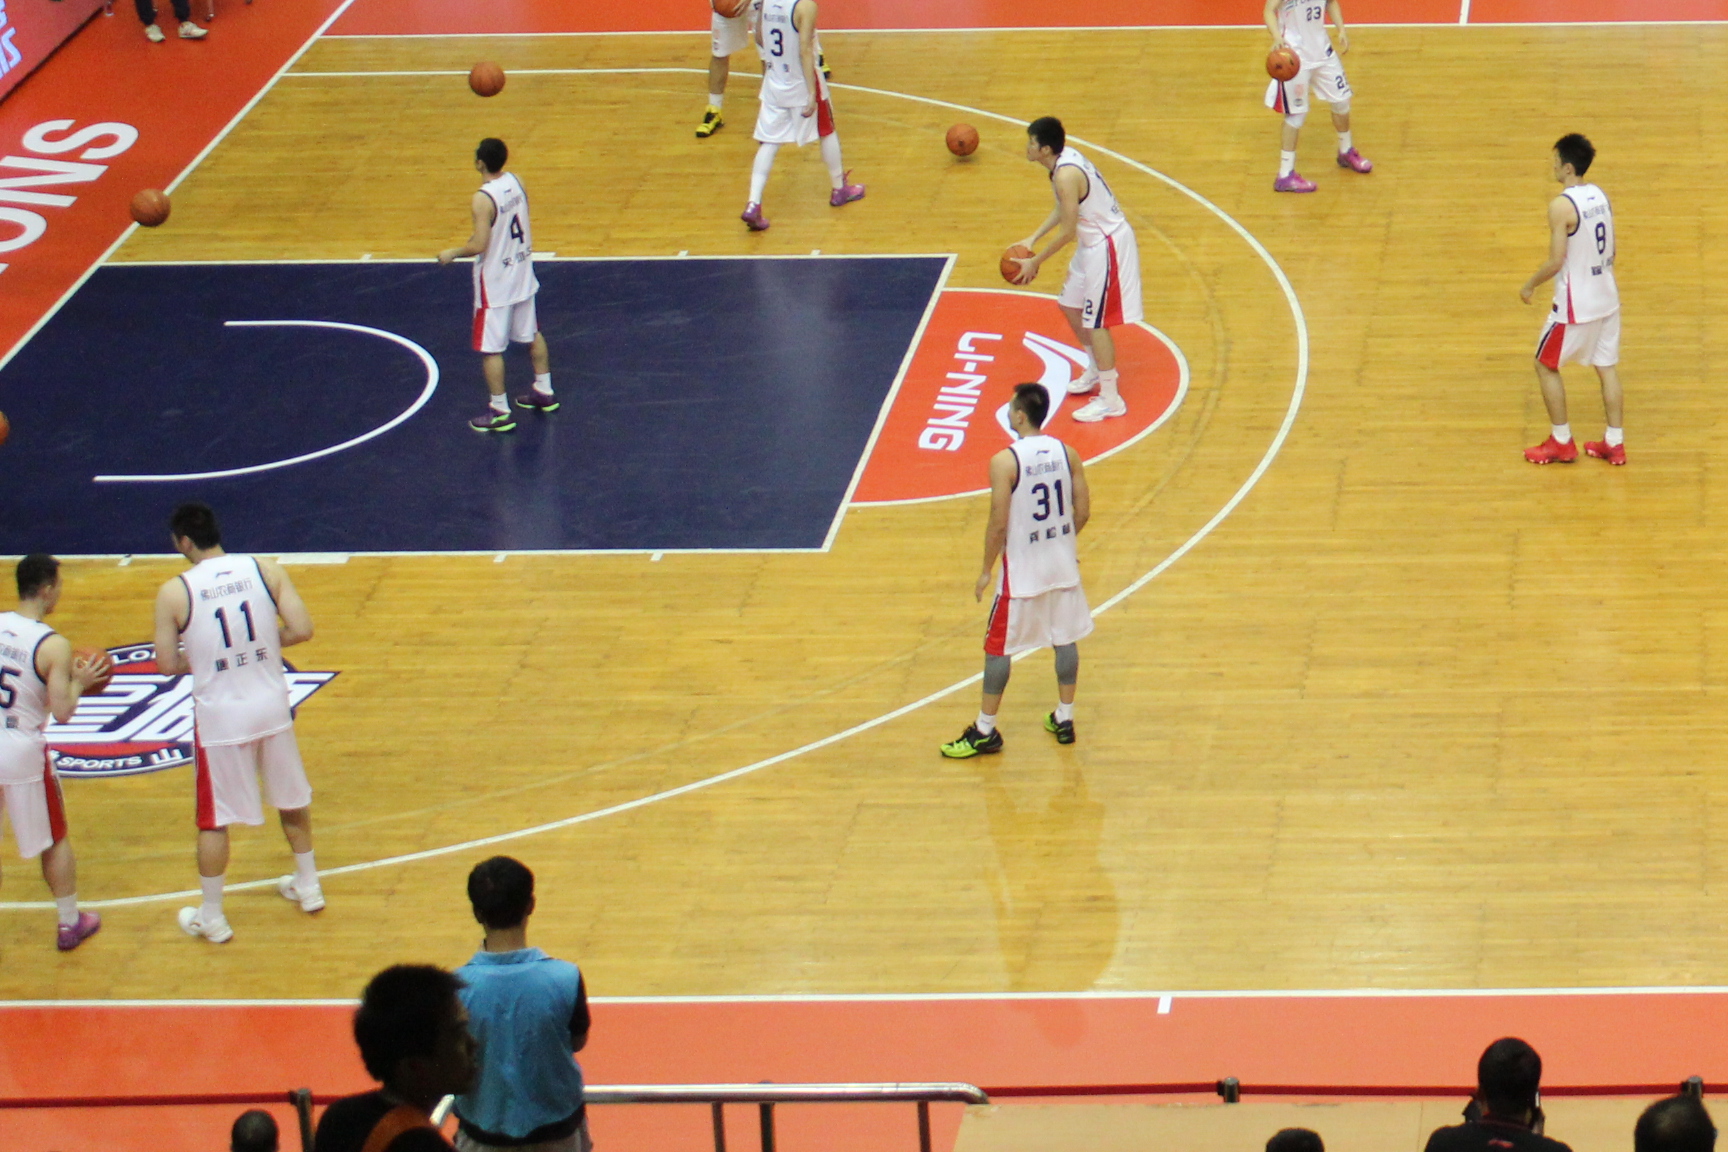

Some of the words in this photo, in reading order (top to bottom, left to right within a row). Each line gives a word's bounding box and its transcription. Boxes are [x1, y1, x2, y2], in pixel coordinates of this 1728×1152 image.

[1306, 6, 1321, 21] 23
[770, 29, 783, 57] 3
[510, 213, 524, 244] 4
[918, 331, 1003, 451] LI-NING
[1031, 478, 1064, 522] 31
[214, 599, 257, 649] 11
[57, 753, 143, 769] SPORTS
[149, 747, 184, 765] 山
